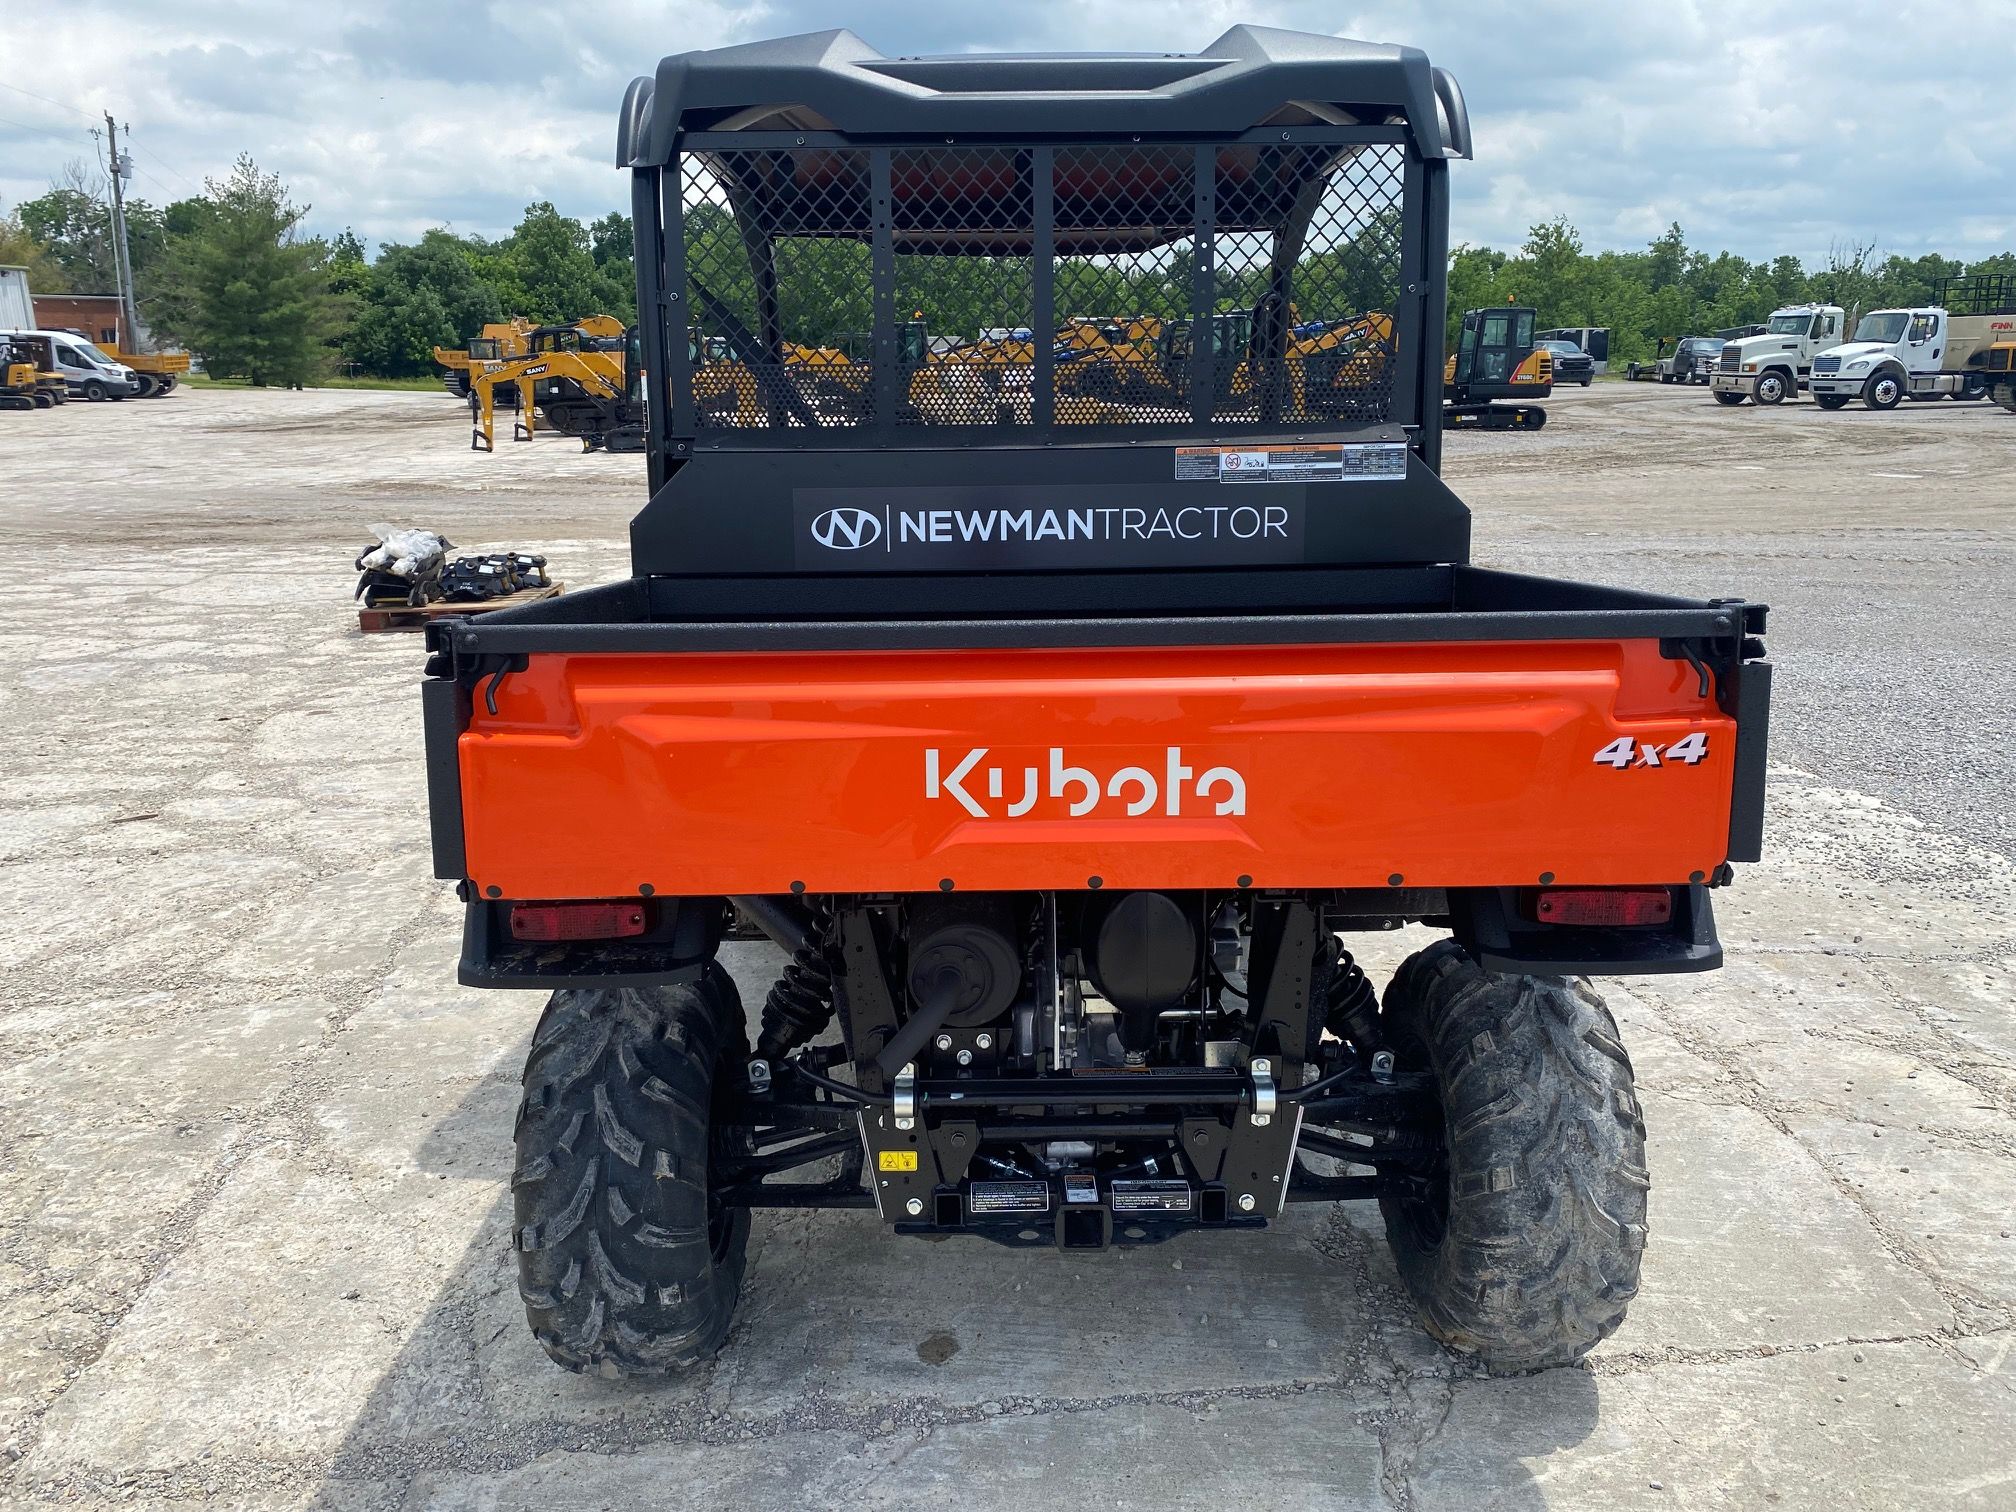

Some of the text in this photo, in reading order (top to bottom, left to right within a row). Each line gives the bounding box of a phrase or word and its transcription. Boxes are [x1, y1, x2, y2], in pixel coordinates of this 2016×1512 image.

[526, 366, 545, 375] SANY
[1593, 732, 1709, 769] 4x4
[925, 746, 1247, 818] Kubota
